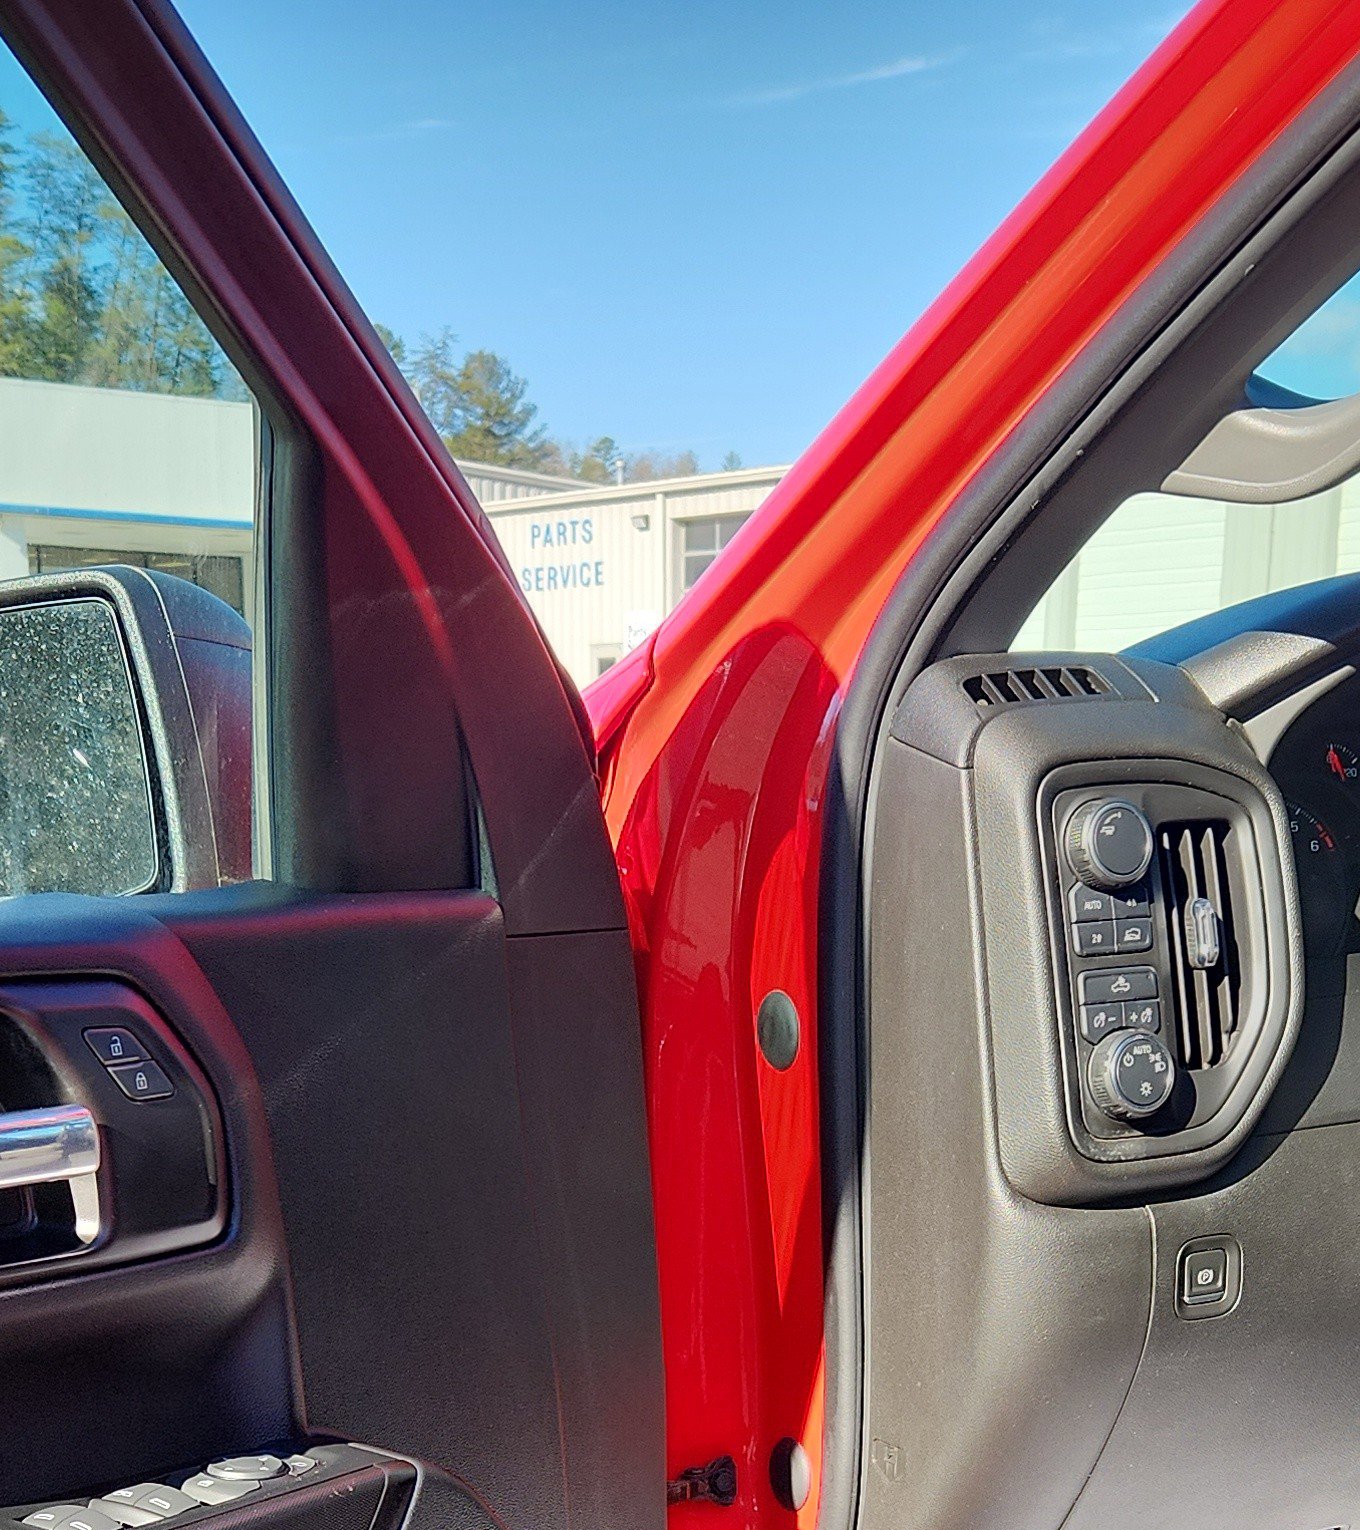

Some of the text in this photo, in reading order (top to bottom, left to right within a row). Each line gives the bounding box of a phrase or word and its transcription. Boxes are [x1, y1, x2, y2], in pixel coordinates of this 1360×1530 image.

[530, 518, 593, 549] PARTS
[522, 561, 605, 591] SERVICE
[1290, 821, 1299, 833] 5
[1310, 840, 1320, 852] 6
[1133, 1044, 1153, 1056] AUTO
